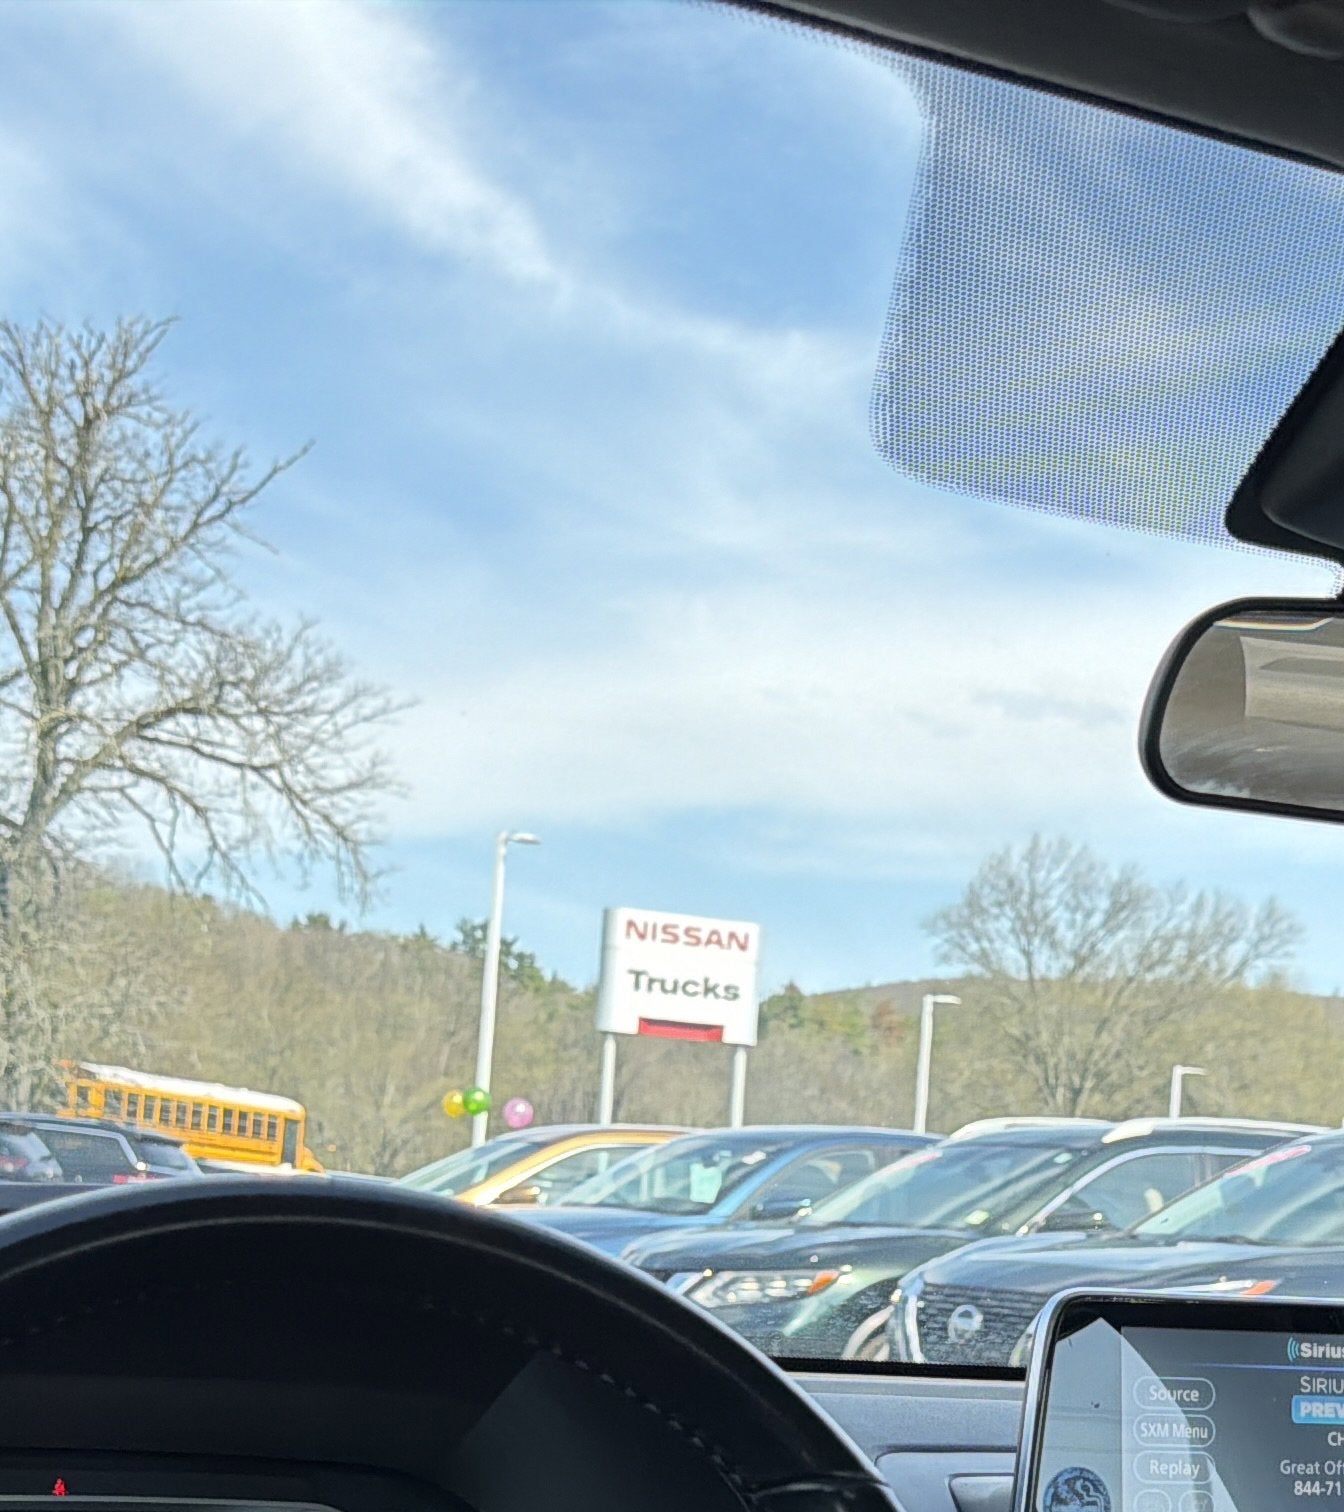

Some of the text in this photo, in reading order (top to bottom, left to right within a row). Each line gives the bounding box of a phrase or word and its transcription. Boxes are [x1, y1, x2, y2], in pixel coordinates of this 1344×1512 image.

[624, 918, 750, 952] NISSAN
[627, 968, 741, 1002] Trucks
[1149, 1385, 1200, 1402] Source
[1140, 1423, 1208, 1440] SXM Menu
[1149, 1459, 1200, 1478] Replay
[1280, 1459, 1320, 1476] Great
